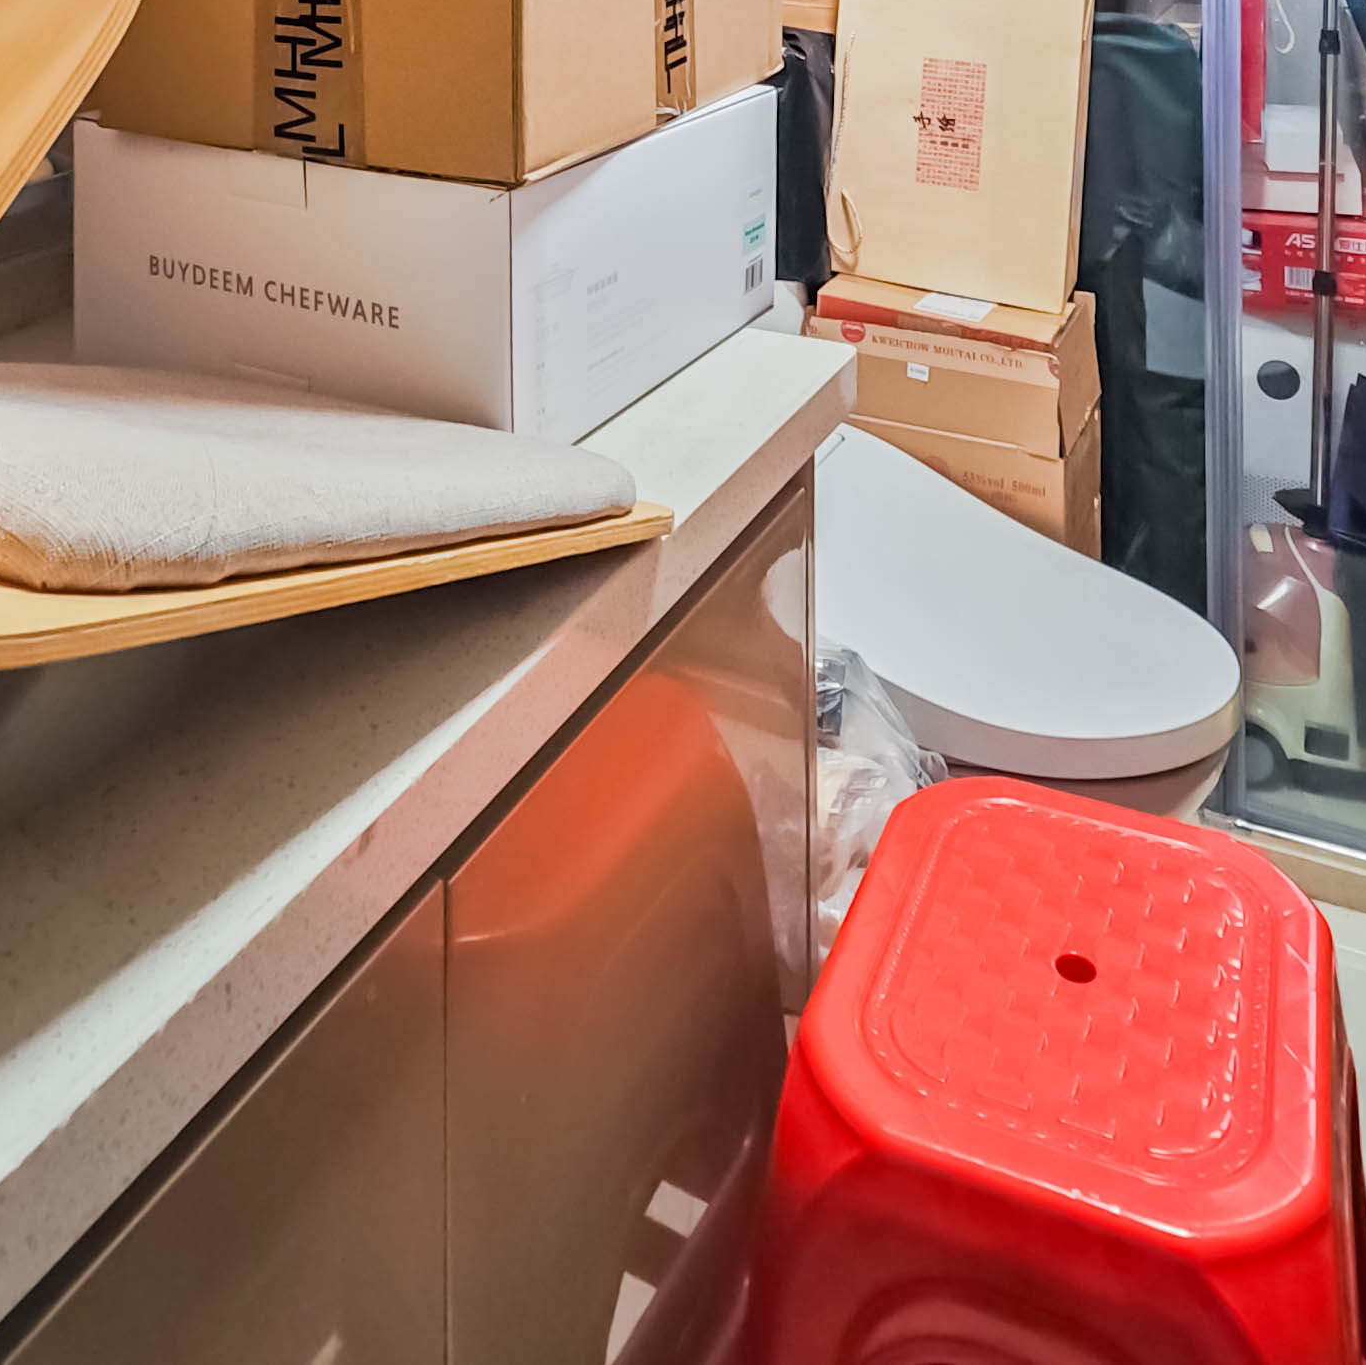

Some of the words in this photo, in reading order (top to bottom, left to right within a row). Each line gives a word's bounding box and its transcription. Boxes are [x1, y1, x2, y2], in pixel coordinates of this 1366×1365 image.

[1285, 233, 1316, 249] AS
[149, 254, 254, 298] BUYDEEM
[264, 280, 400, 330] CHEFWARE
[871, 334, 930, 353] KWEICHOW
[933, 345, 977, 363] MOUTAI
